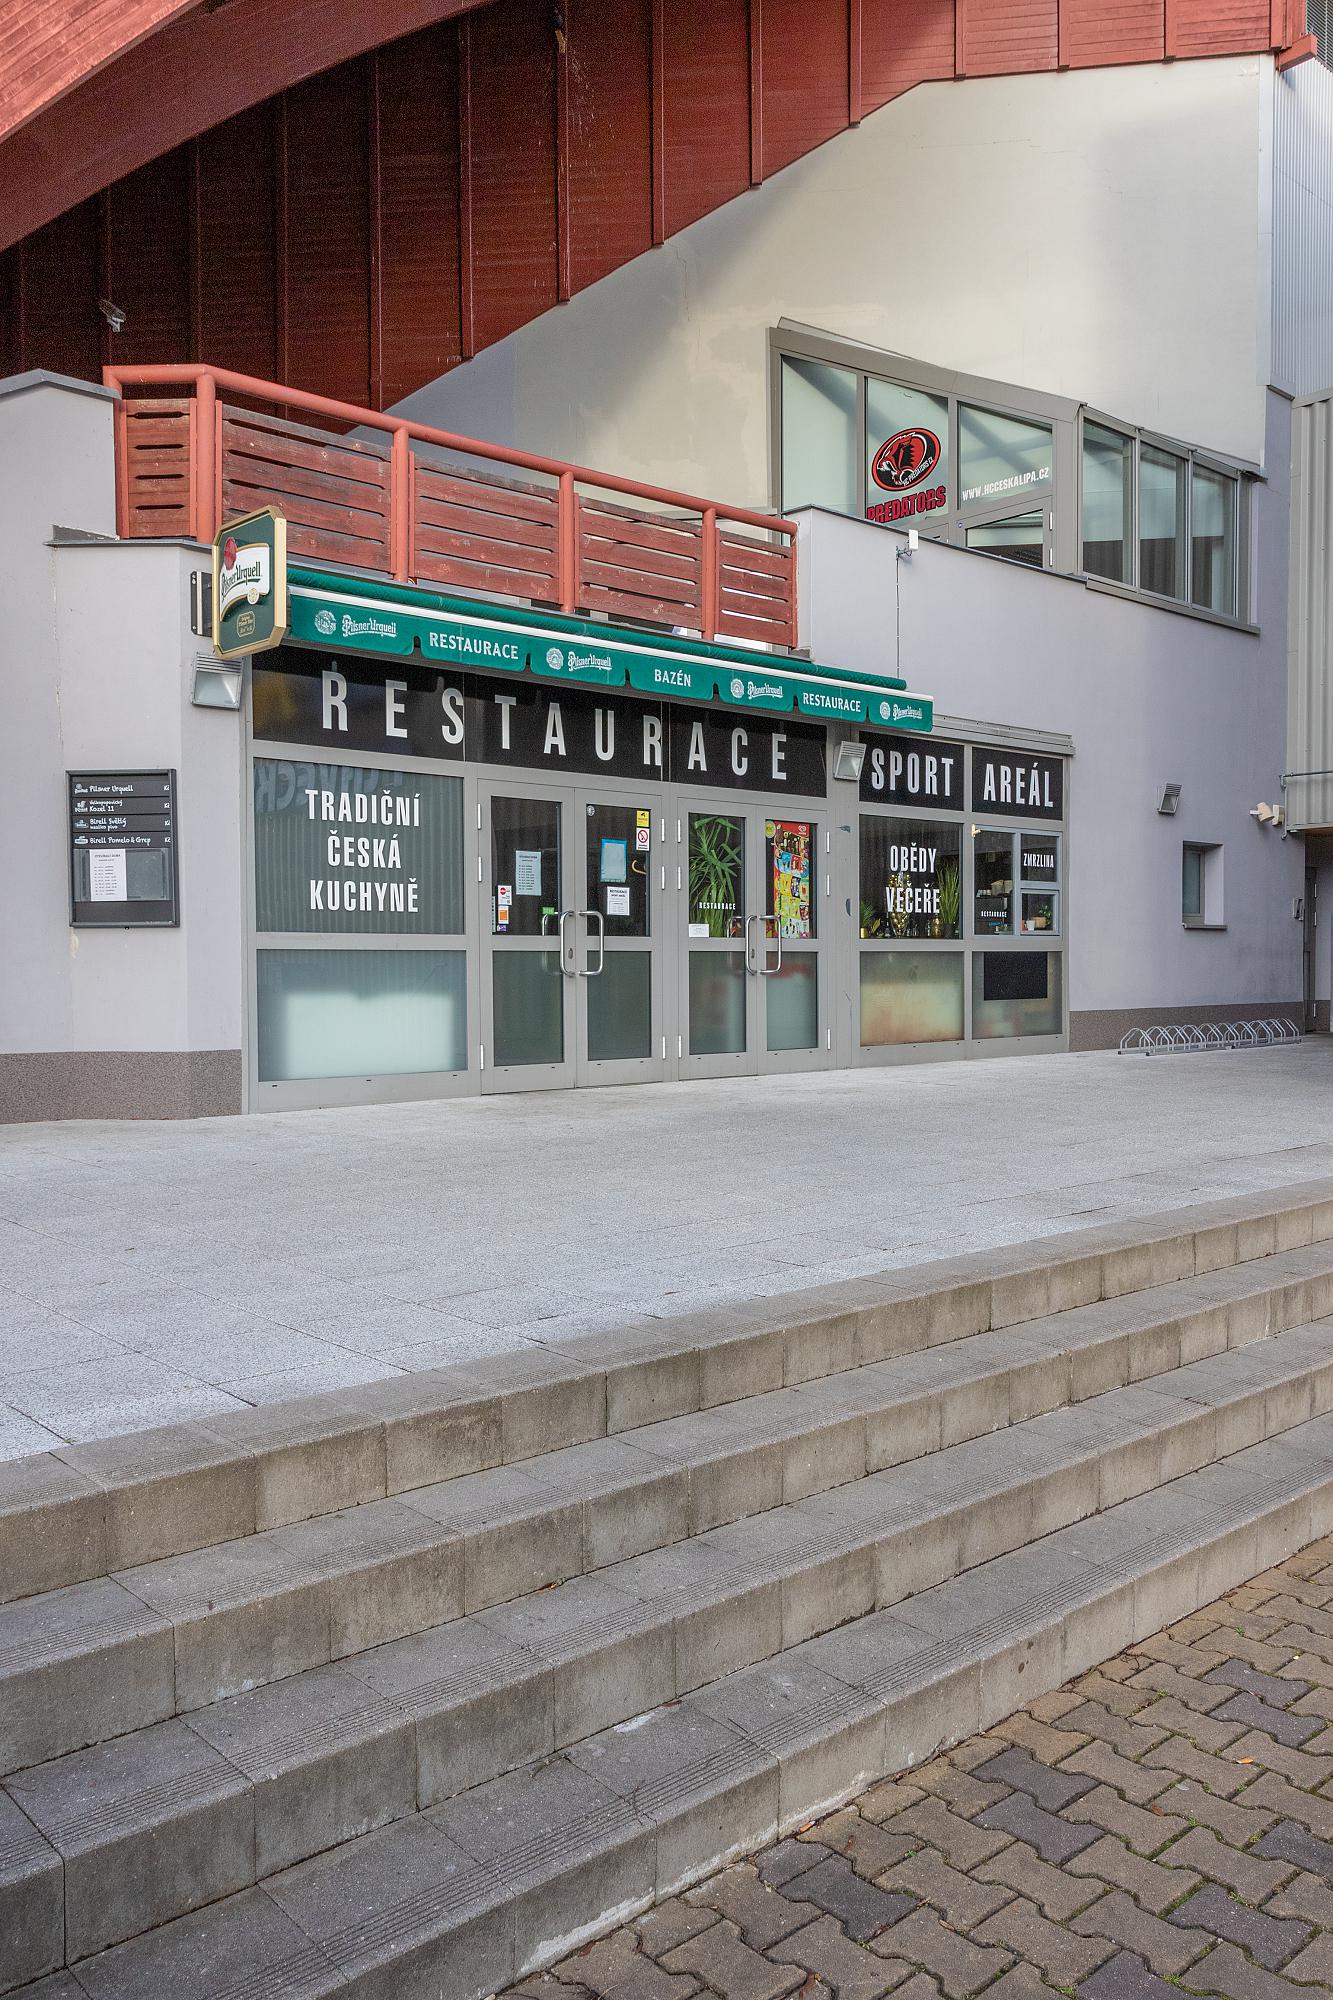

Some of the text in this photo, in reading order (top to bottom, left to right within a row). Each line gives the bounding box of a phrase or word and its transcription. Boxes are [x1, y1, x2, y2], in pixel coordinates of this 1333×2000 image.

[962, 467, 1049, 501] WWW.HCCESKALIPA.CZ
[867, 485, 946, 524] PREDATORS
[236, 561, 262, 585] Urquell
[342, 614, 397, 637] Pilsner Urquell
[429, 632, 519, 660] RESTAURACE
[568, 651, 612, 672] Pilsner Urquell
[654, 669, 691, 687] BAZÉN
[802, 692, 861, 713] RESTAURACE
[322, 669, 787, 781] RESTAURACE
[89, 785, 111, 793] Pilsner
[111, 785, 133, 795] Urquell
[871, 748, 1054, 808] SPORT AREÁL
[305, 789, 420, 827] TRADIČNÍ
[327, 830, 401, 869] ČESKÁ
[890, 842, 937, 873] OBĚDY
[1023, 853, 1054, 868] ZMRZLINA
[310, 877, 418, 913] KUCHYNĚ
[699, 902, 736, 910] RESTAURACE
[886, 882, 940, 914] VEČEŘE
